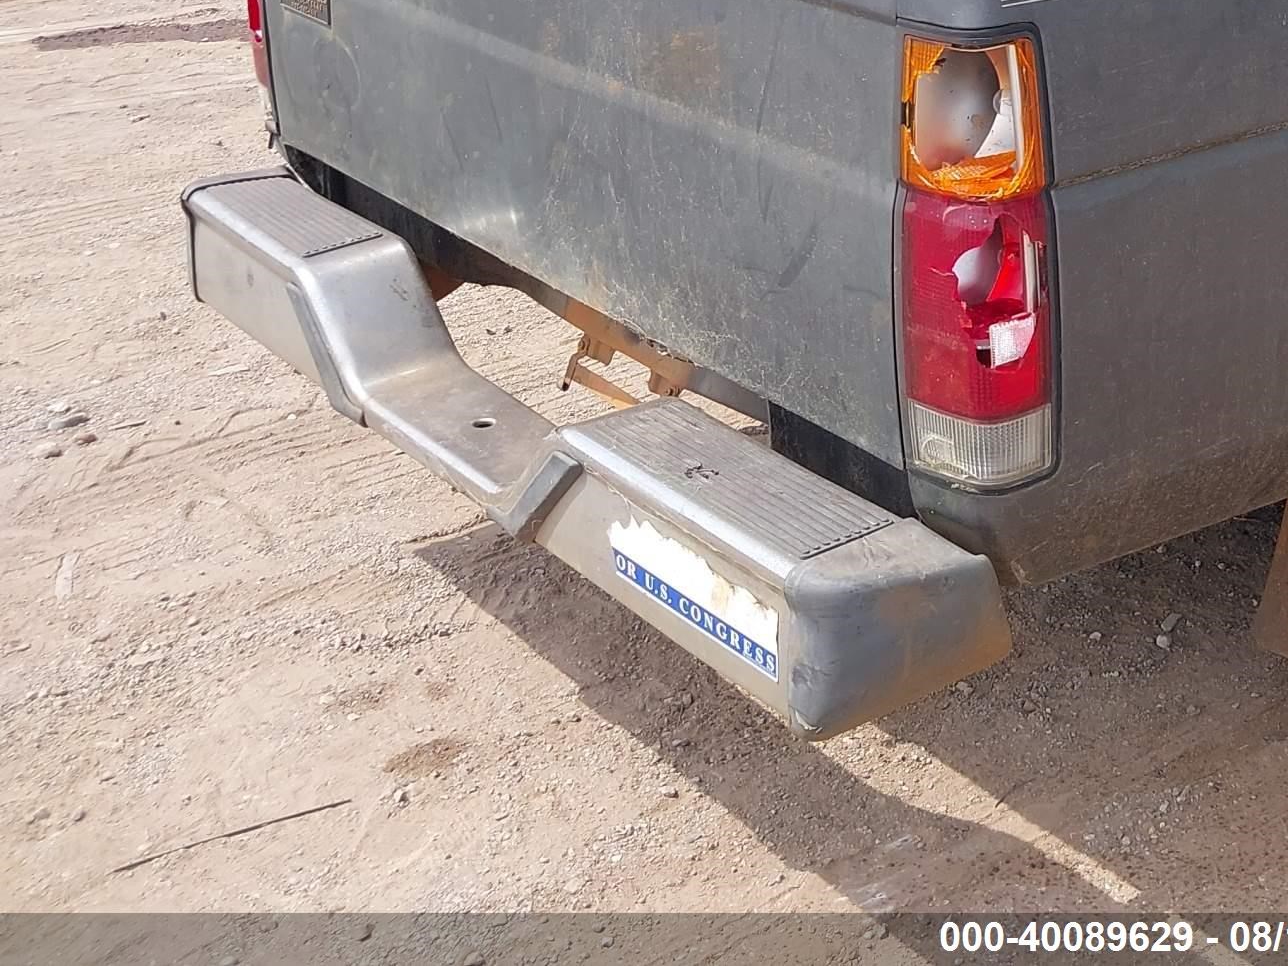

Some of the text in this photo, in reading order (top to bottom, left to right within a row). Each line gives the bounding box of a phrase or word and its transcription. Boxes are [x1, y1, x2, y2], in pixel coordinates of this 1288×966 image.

[616, 554, 637, 580] OR
[645, 574, 672, 604] U.S.
[679, 597, 775, 672] CONGRESS
